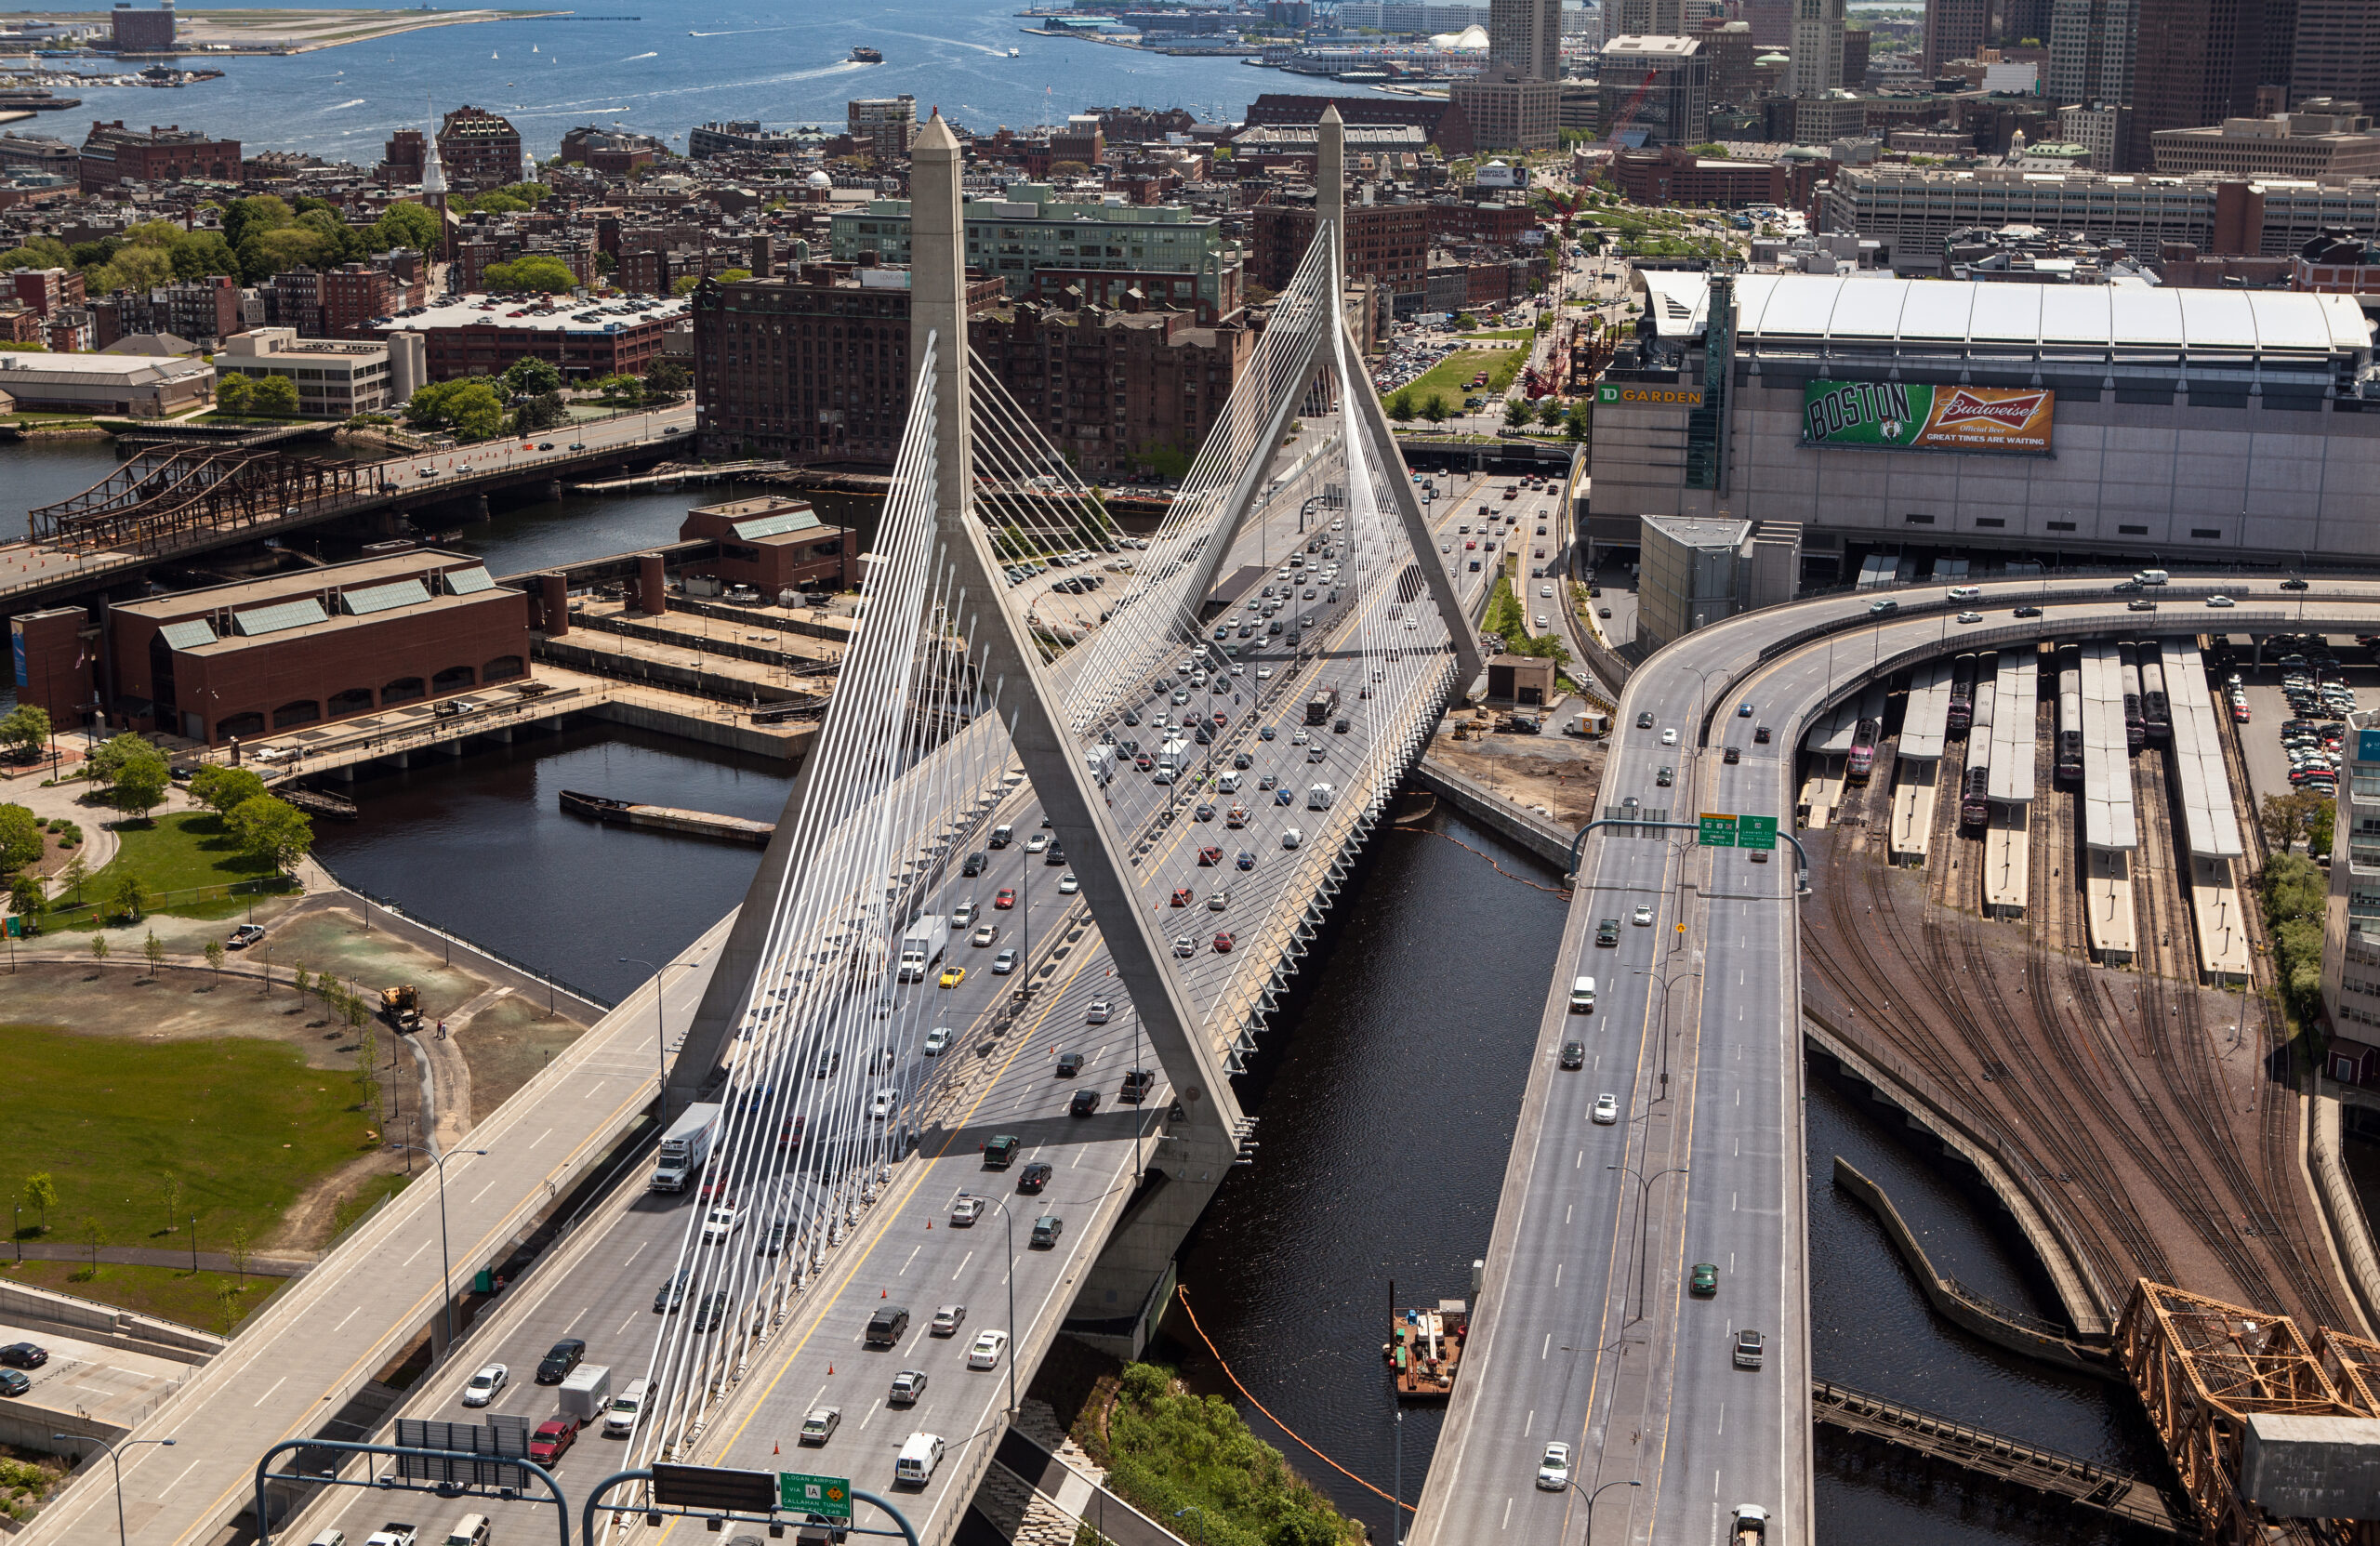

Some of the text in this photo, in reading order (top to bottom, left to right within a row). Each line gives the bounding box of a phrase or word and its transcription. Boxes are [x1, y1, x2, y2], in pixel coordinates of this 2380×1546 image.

[1601, 388, 1701, 403] TD GARDEN
[1807, 382, 1912, 442] BOSTON
[1937, 398, 2040, 416] Budweiser
[1959, 424, 2006, 434] Official Beer
[1958, 434, 1986, 443] TIMES
[2006, 437, 2044, 445] WAITING
[808, 1487, 818, 1496] 1A
[783, 1498, 849, 1510] CALLAHAN TUNNEL
